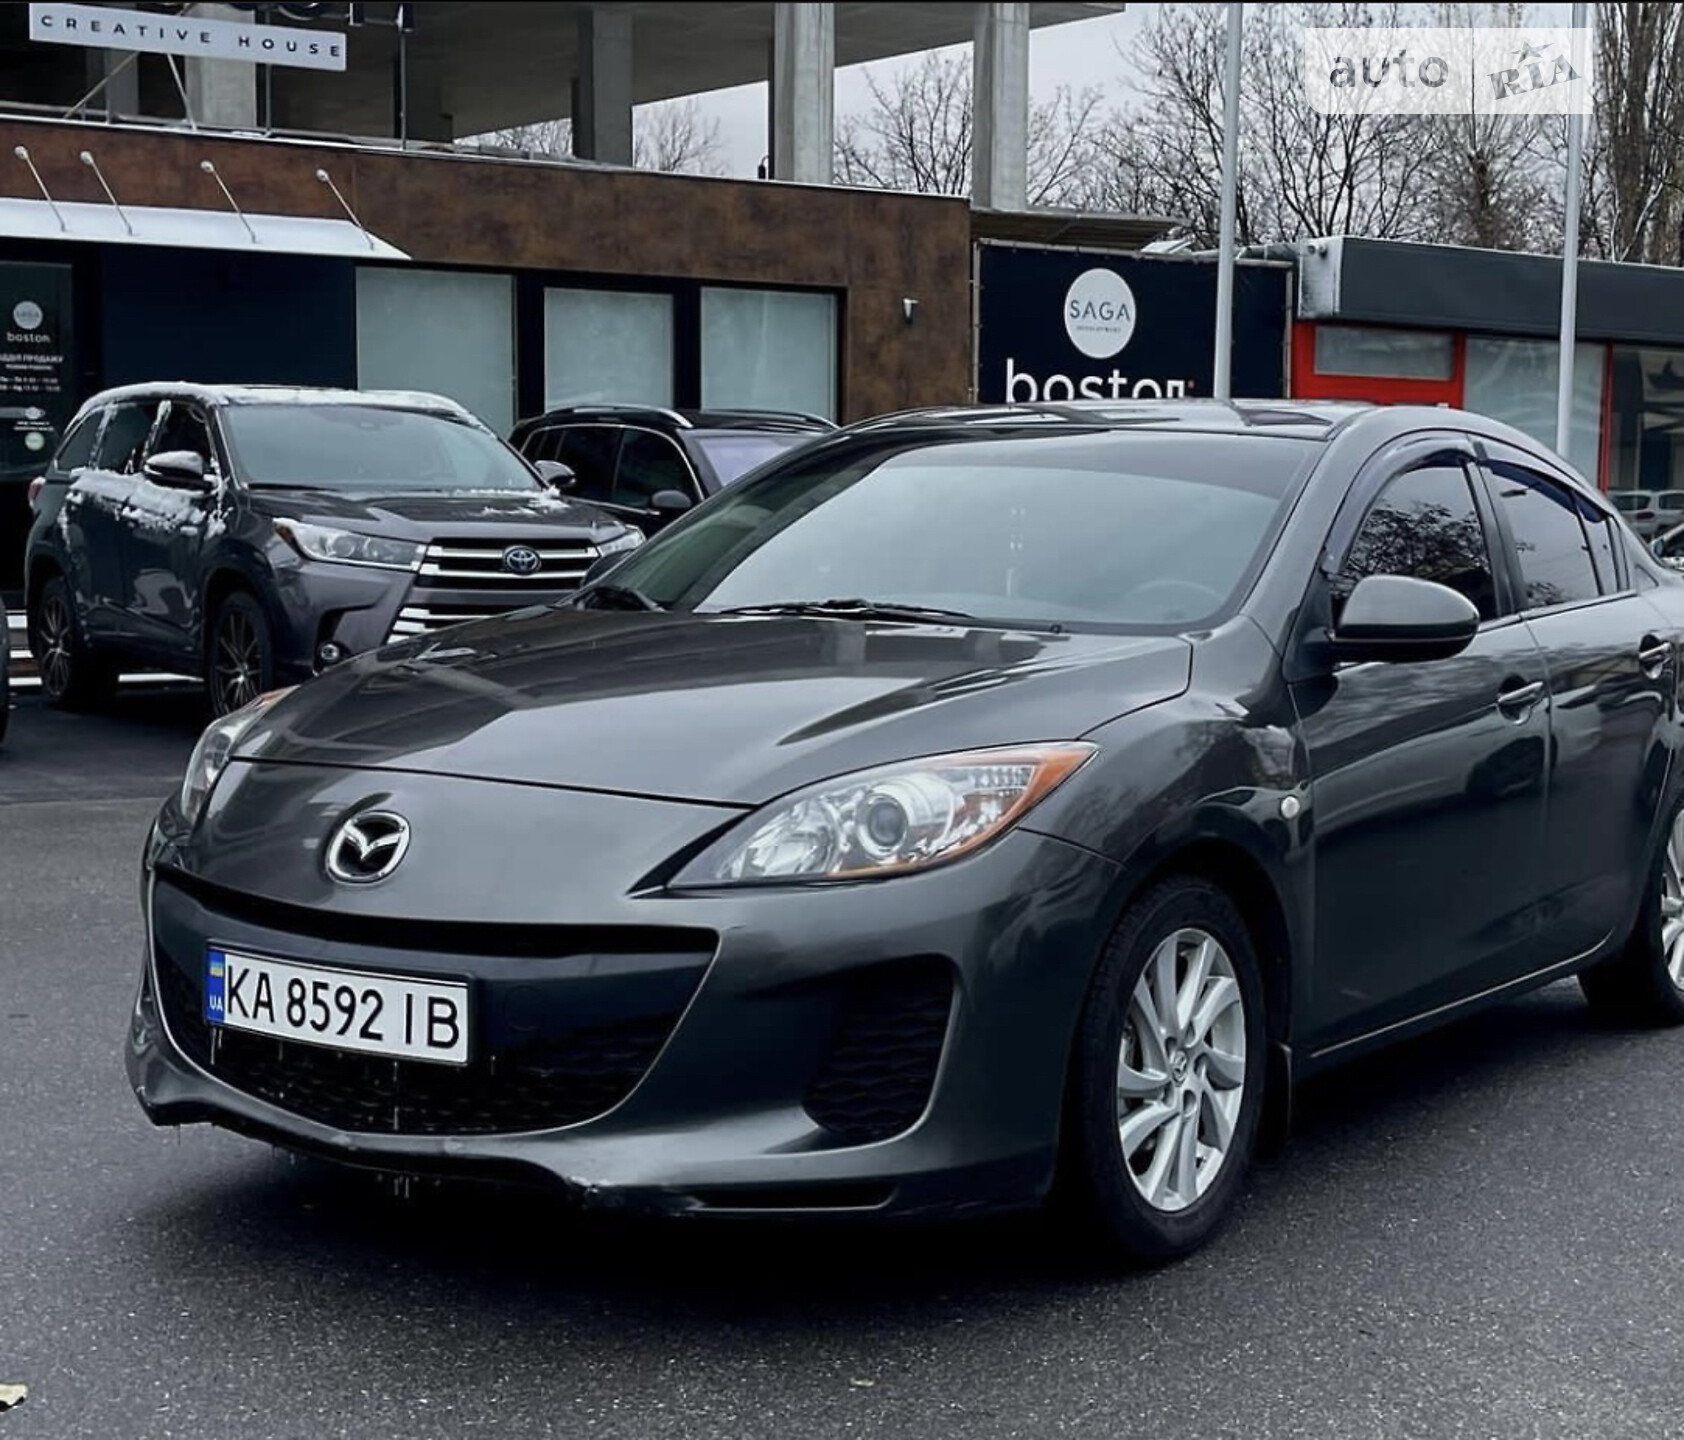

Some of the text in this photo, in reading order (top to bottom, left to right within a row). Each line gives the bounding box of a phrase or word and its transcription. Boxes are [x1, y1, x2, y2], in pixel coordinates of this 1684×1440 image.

[41, 15, 211, 44] CREATIVE
[238, 36, 340, 57] HOUSE
[1070, 299, 1131, 321] SAGA
[6, 331, 51, 343] boston
[209, 994, 223, 1012] UA
[228, 965, 460, 1050] KA 8592 IB
